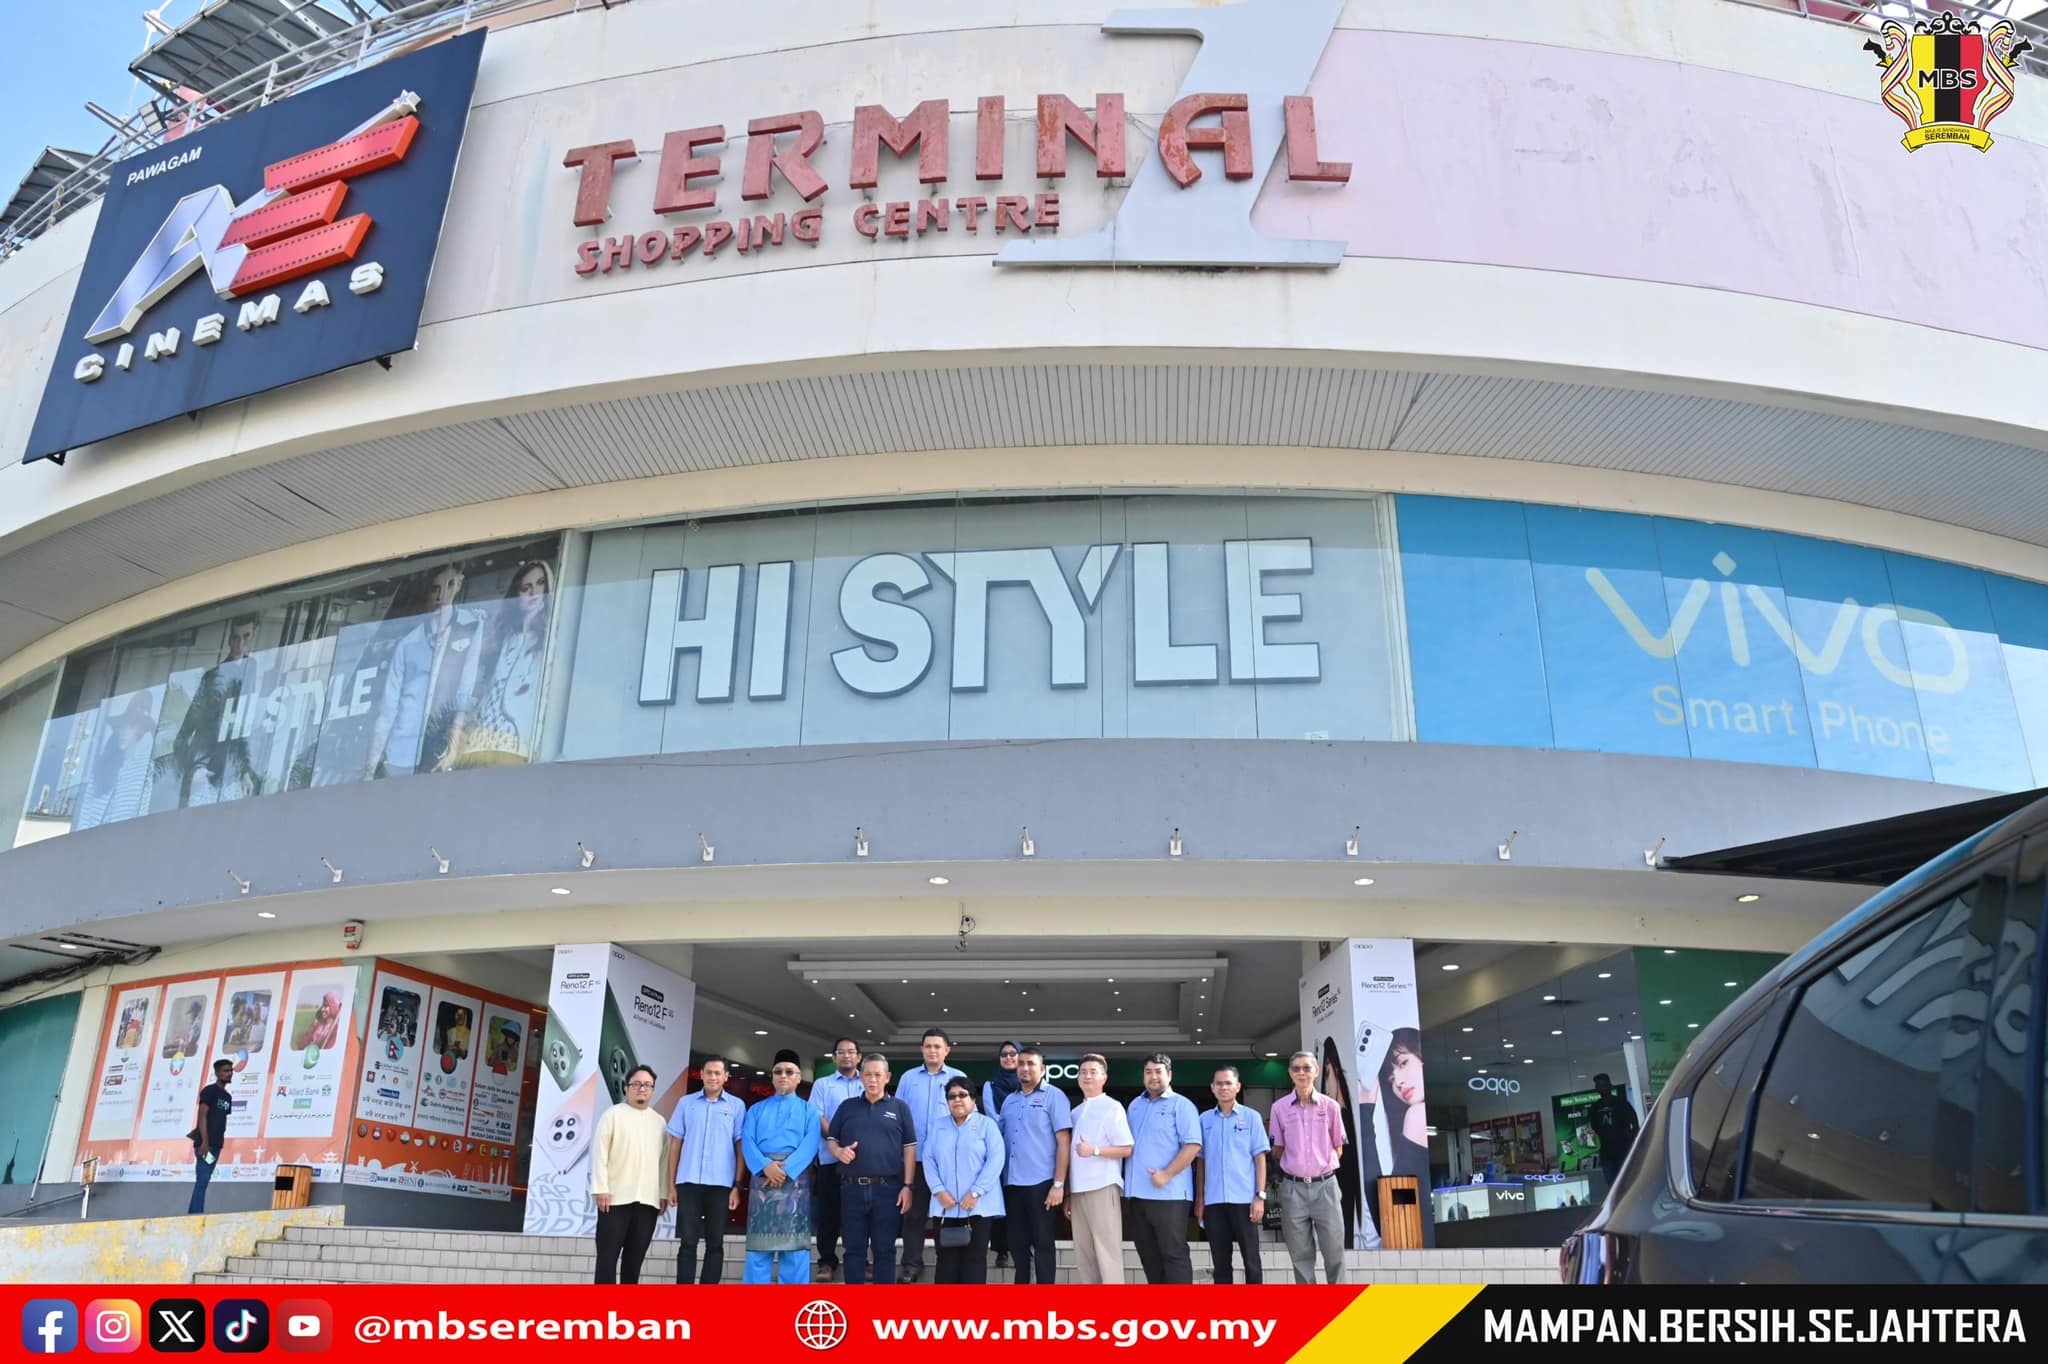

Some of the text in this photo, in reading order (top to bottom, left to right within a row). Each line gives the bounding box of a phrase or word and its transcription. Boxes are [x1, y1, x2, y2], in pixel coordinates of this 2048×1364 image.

[126, 146, 203, 187] PAWAGAM
[562, 92, 1353, 227] TERMINAL
[575, 193, 1060, 277] SHOPPING CENTRE
[73, 261, 385, 384] CINEMAS
[638, 536, 1322, 707] HI STYLE
[1585, 551, 1970, 695] vivo
[261, 666, 379, 735] STYLE
[1651, 684, 1952, 754] Smart Phone
[633, 995, 661, 1019] Reno12
[1496, 1190, 1525, 1201] vivo
